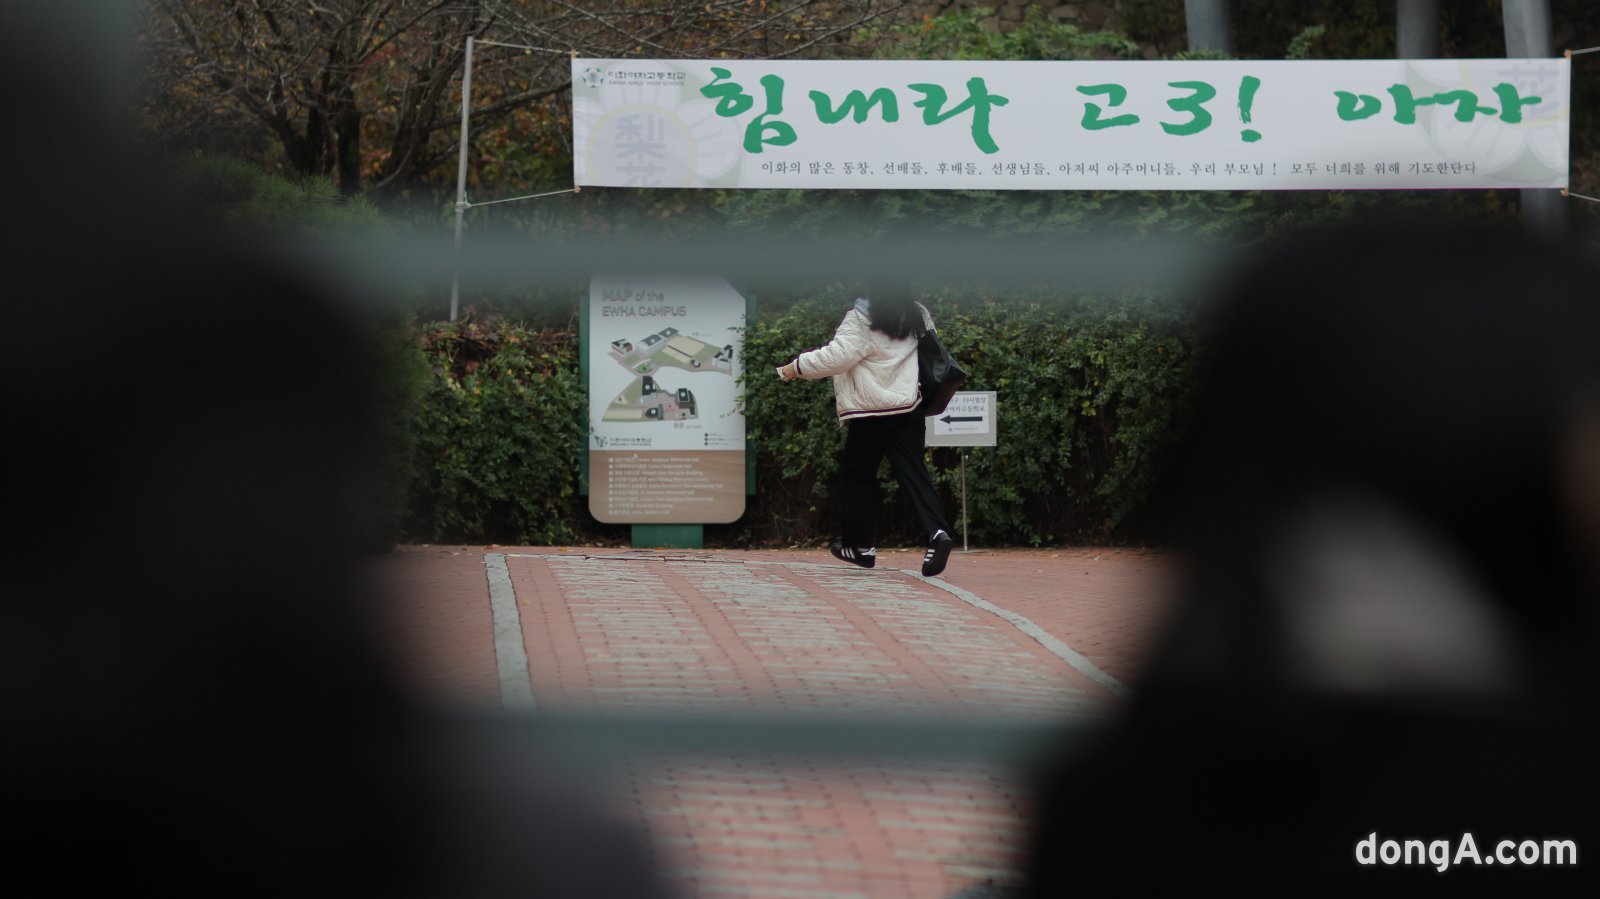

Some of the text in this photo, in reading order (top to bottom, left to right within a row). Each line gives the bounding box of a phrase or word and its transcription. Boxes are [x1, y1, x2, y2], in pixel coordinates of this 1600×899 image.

[700, 67, 1009, 154] 힘내라
[1335, 84, 1542, 125] 아자
[761, 162, 801, 175] 이화의
[809, 162, 835, 175] 많은
[1058, 162, 1099, 176] 아저씨
[1190, 162, 1216, 176] 우리
[1291, 162, 1317, 175] 모두
[1326, 162, 1366, 175] 너희를
[1374, 162, 1400, 175] 위해
[1408, 162, 1477, 175] 기도한단다
[635, 289, 646, 302] of
[647, 289, 665, 302] the
[602, 305, 687, 317] EWHA CAMPUS
